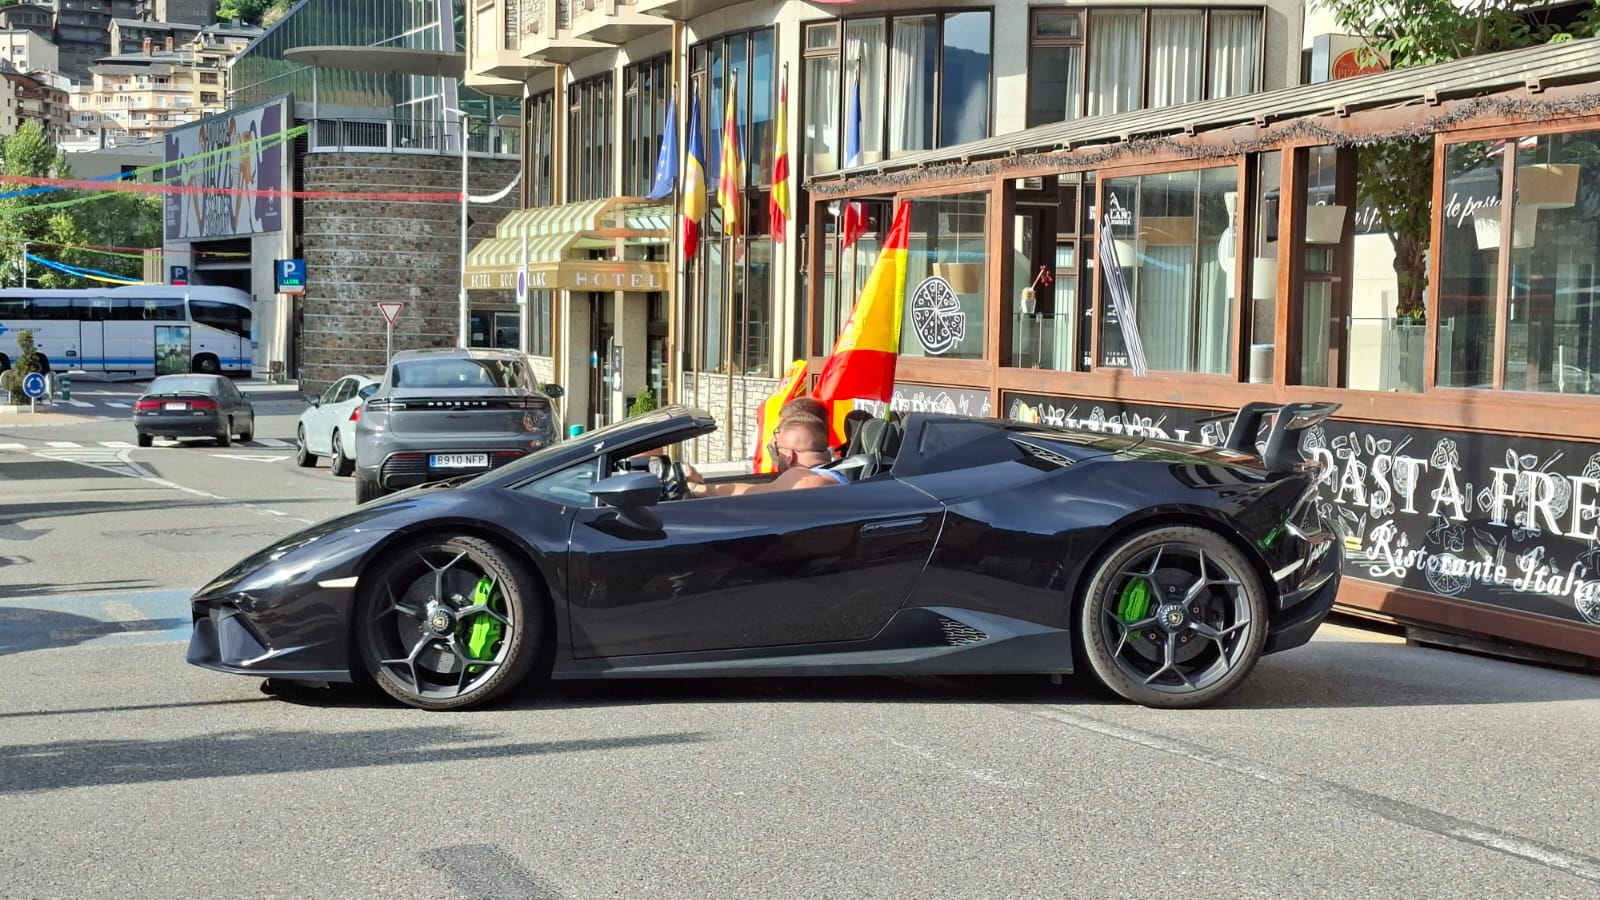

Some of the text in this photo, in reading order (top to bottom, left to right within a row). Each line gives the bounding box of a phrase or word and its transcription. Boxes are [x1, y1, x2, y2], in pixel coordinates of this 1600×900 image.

[175, 267, 184, 278] P
[284, 261, 296, 277] P
[575, 272, 661, 289] HOTEL
[1105, 356, 1128, 366] LANC
[465, 454, 485, 465] NFP
[1309, 446, 1468, 522] PASTA
[1366, 519, 1508, 585] Ristorante
